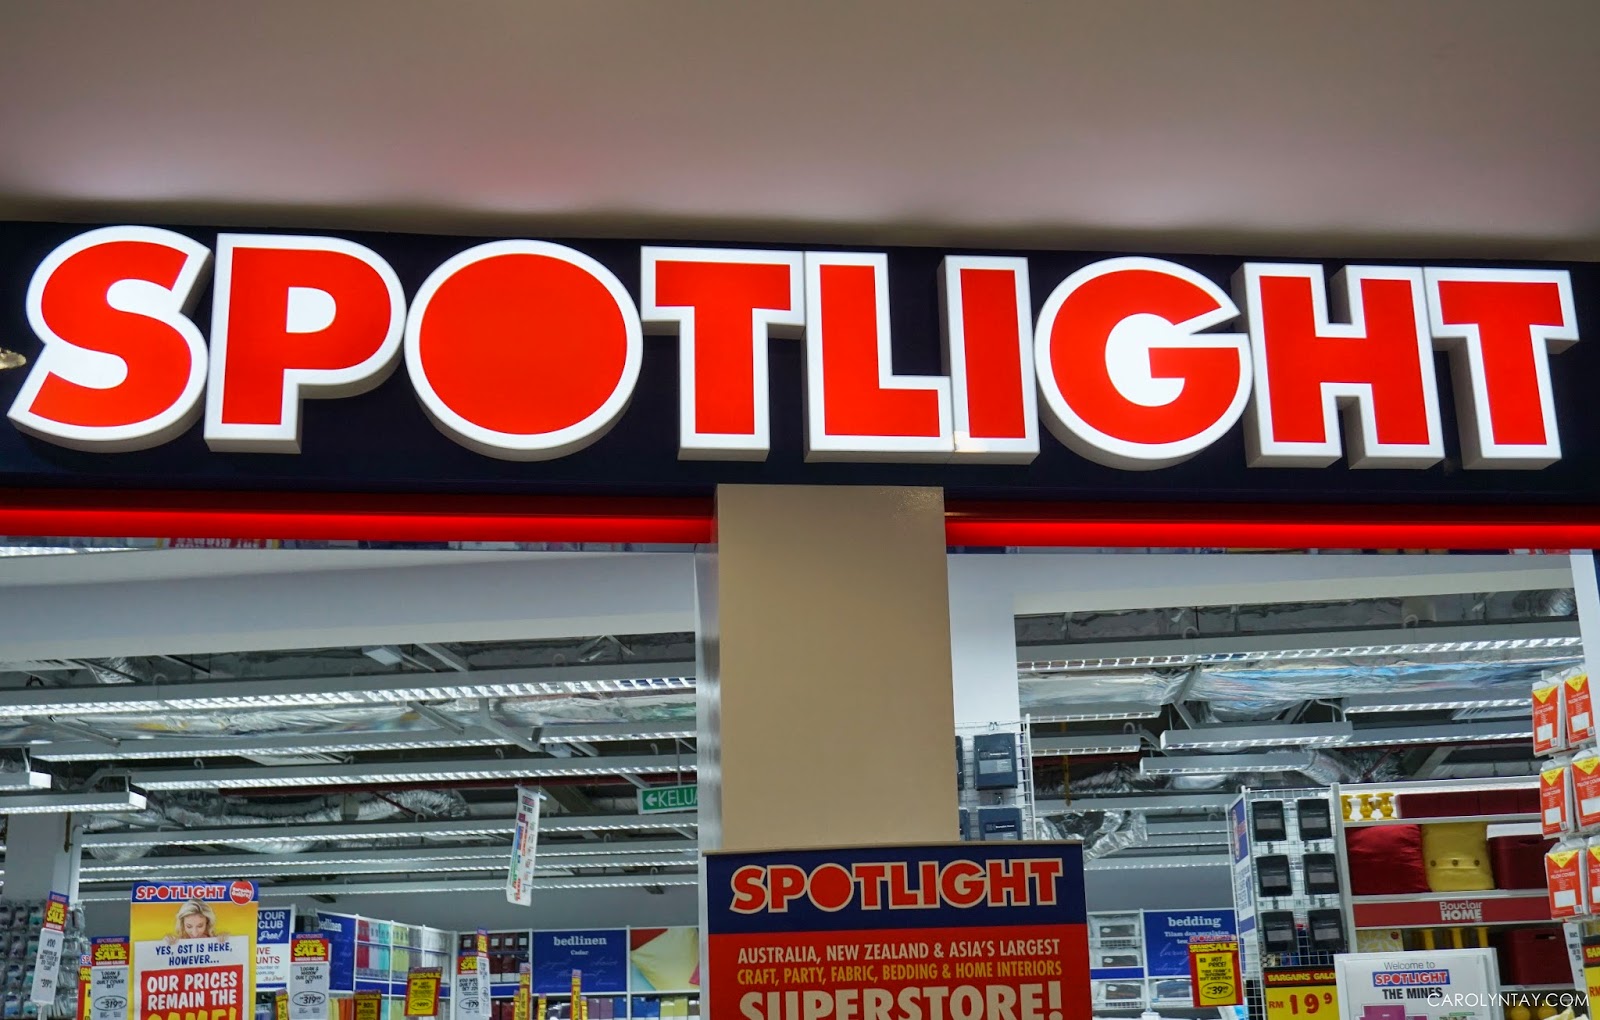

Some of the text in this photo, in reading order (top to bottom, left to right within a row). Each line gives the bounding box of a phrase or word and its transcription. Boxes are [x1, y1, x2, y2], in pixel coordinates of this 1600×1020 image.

[8, 226, 1581, 470] SPOTLIGHT
[136, 885, 226, 900] SPOTLIGHT
[730, 858, 1064, 915] SPOTLIGHT
[264, 911, 285, 920] OUR
[1441, 909, 1482, 921] HOME
[258, 920, 284, 929] CLUB
[1168, 916, 1221, 928] bedding
[553, 936, 607, 946] bedlinen
[155, 942, 233, 956] YES, GST IS HERE,
[293, 947, 326, 957] SALE
[738, 946, 821, 965] AUSTRALIA,
[826, 944, 860, 961] NEW
[864, 941, 929, 961] ZEALAND
[933, 942, 944, 958] &
[999, 938, 1061, 956] LARGEST
[95, 951, 127, 961] SALE
[168, 954, 220, 966] HOWEVER...
[1384, 961, 1436, 970] Welcome to
[737, 960, 1063, 987] CRAFT, PARTY, FABRIC, BEDDING & HOME INTERIORS
[1374, 972, 1448, 986] SPOTLIGHT
[147, 971, 238, 993] OUR PRICES
[1382, 987, 1443, 999] THE MINES
[148, 989, 237, 1011] REMAIN THE
